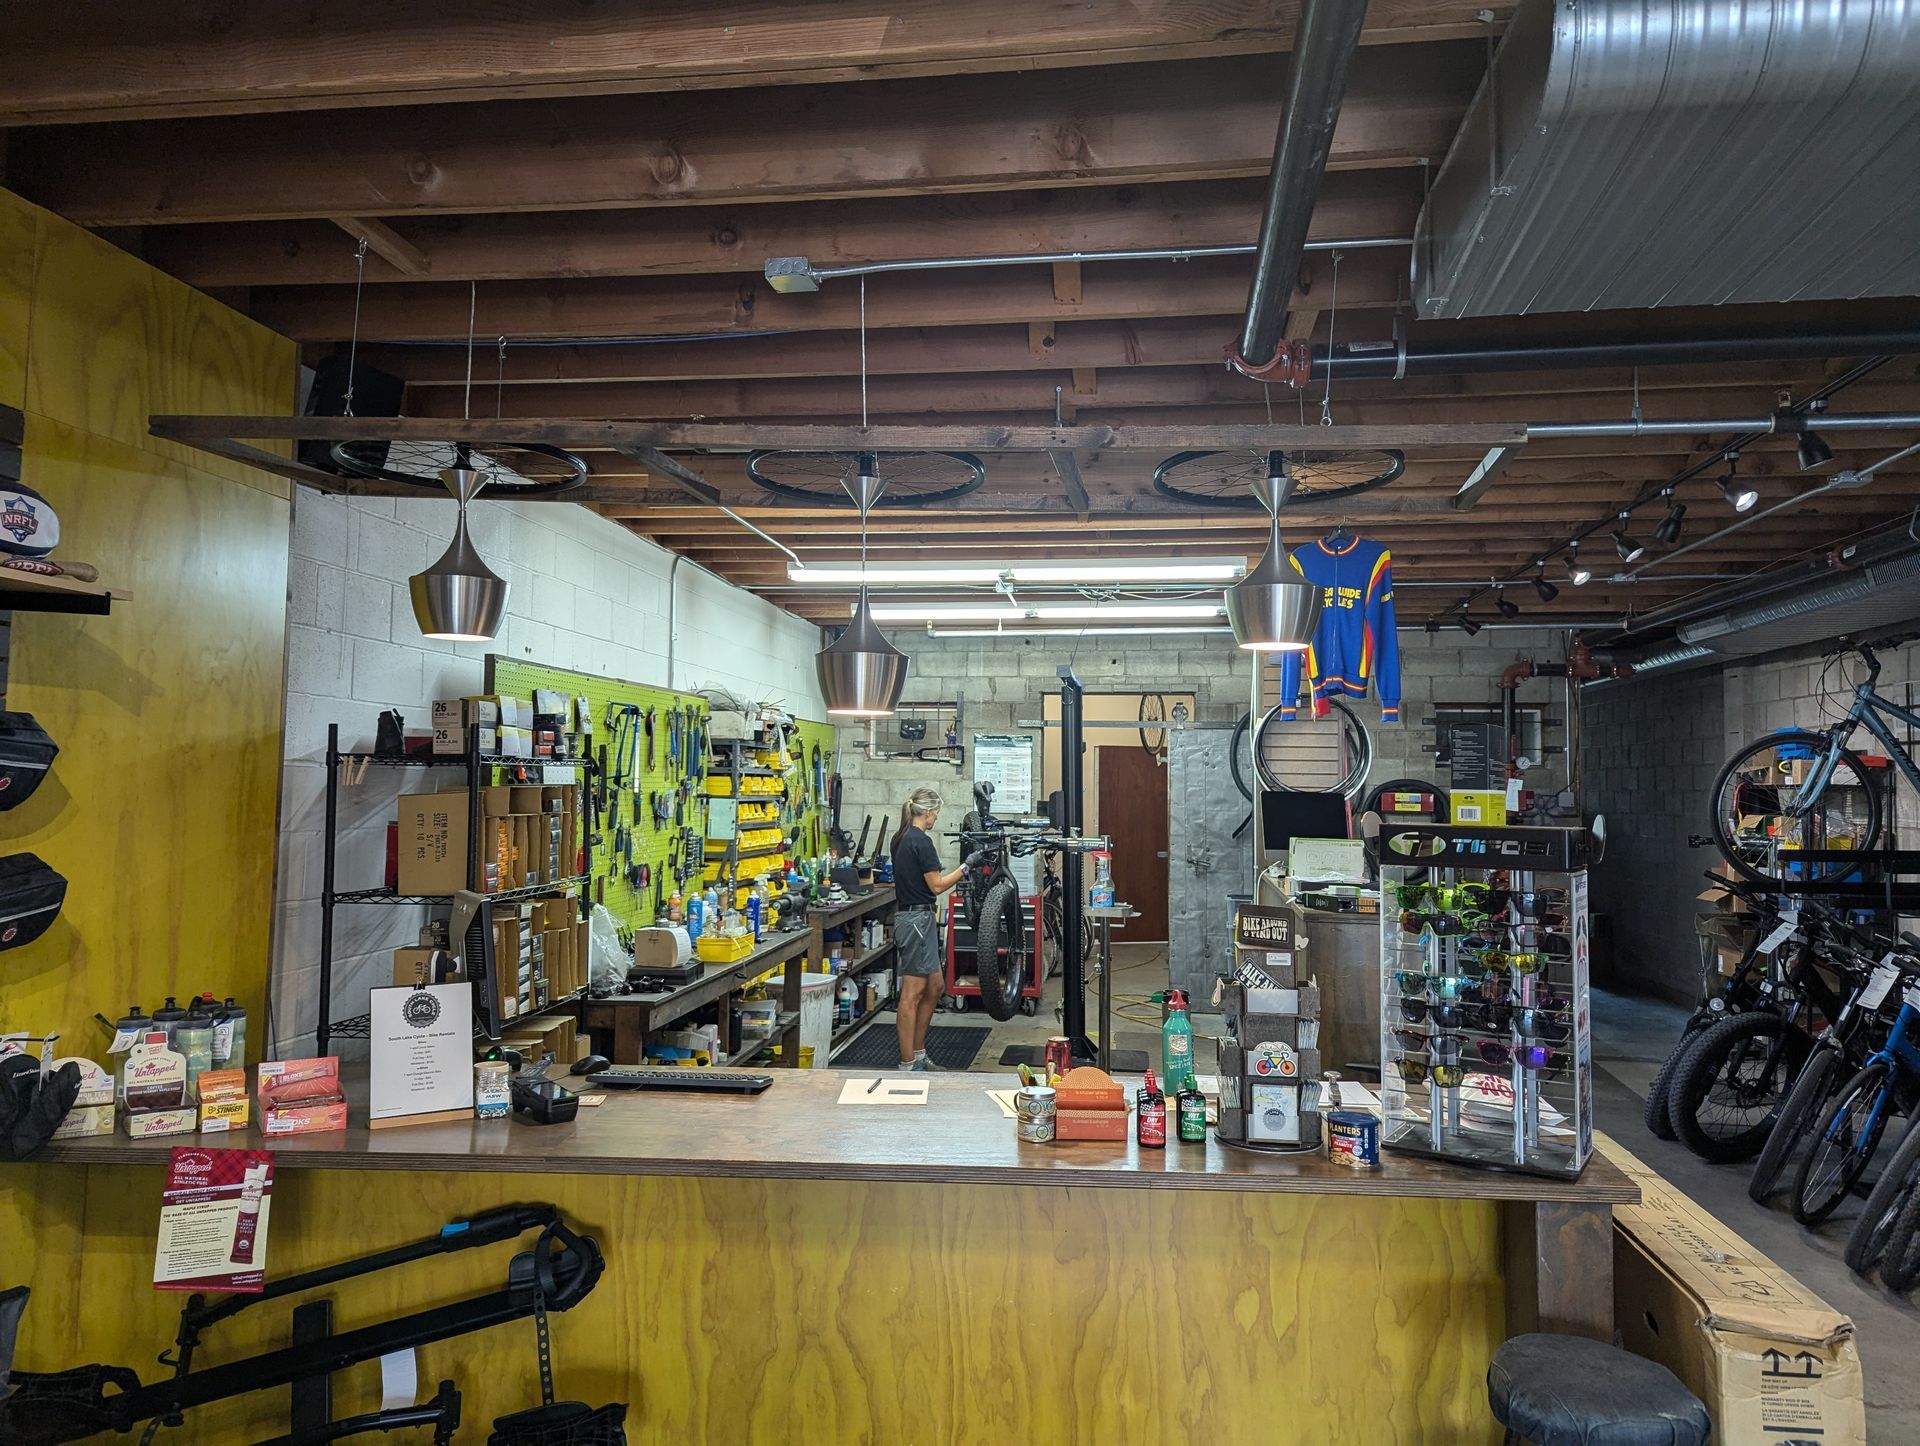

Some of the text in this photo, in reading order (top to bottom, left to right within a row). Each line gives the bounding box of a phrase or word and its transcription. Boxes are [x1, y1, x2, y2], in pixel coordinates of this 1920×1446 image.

[4, 514, 36, 529] NRFL
[1337, 586, 1362, 599] WIDE
[1322, 597, 1354, 609] YCLES
[434, 702, 447, 712] 26
[435, 729, 448, 740] 26
[1883, 731, 1920, 783] cannon
[416, 833, 425, 841] 10
[1242, 916, 1288, 931] BIKE AROUND
[1251, 928, 1271, 939] FIND
[1271, 927, 1288, 941] OUT
[1241, 962, 1264, 987] BIKE
[12, 1069, 29, 1078] Lizard
[134, 1061, 177, 1078] Untapped
[216, 1105, 244, 1115] STINGER
[144, 1117, 184, 1132] Untapped
[292, 1118, 311, 1126] OKS
[174, 1160, 213, 1175] Untapped
